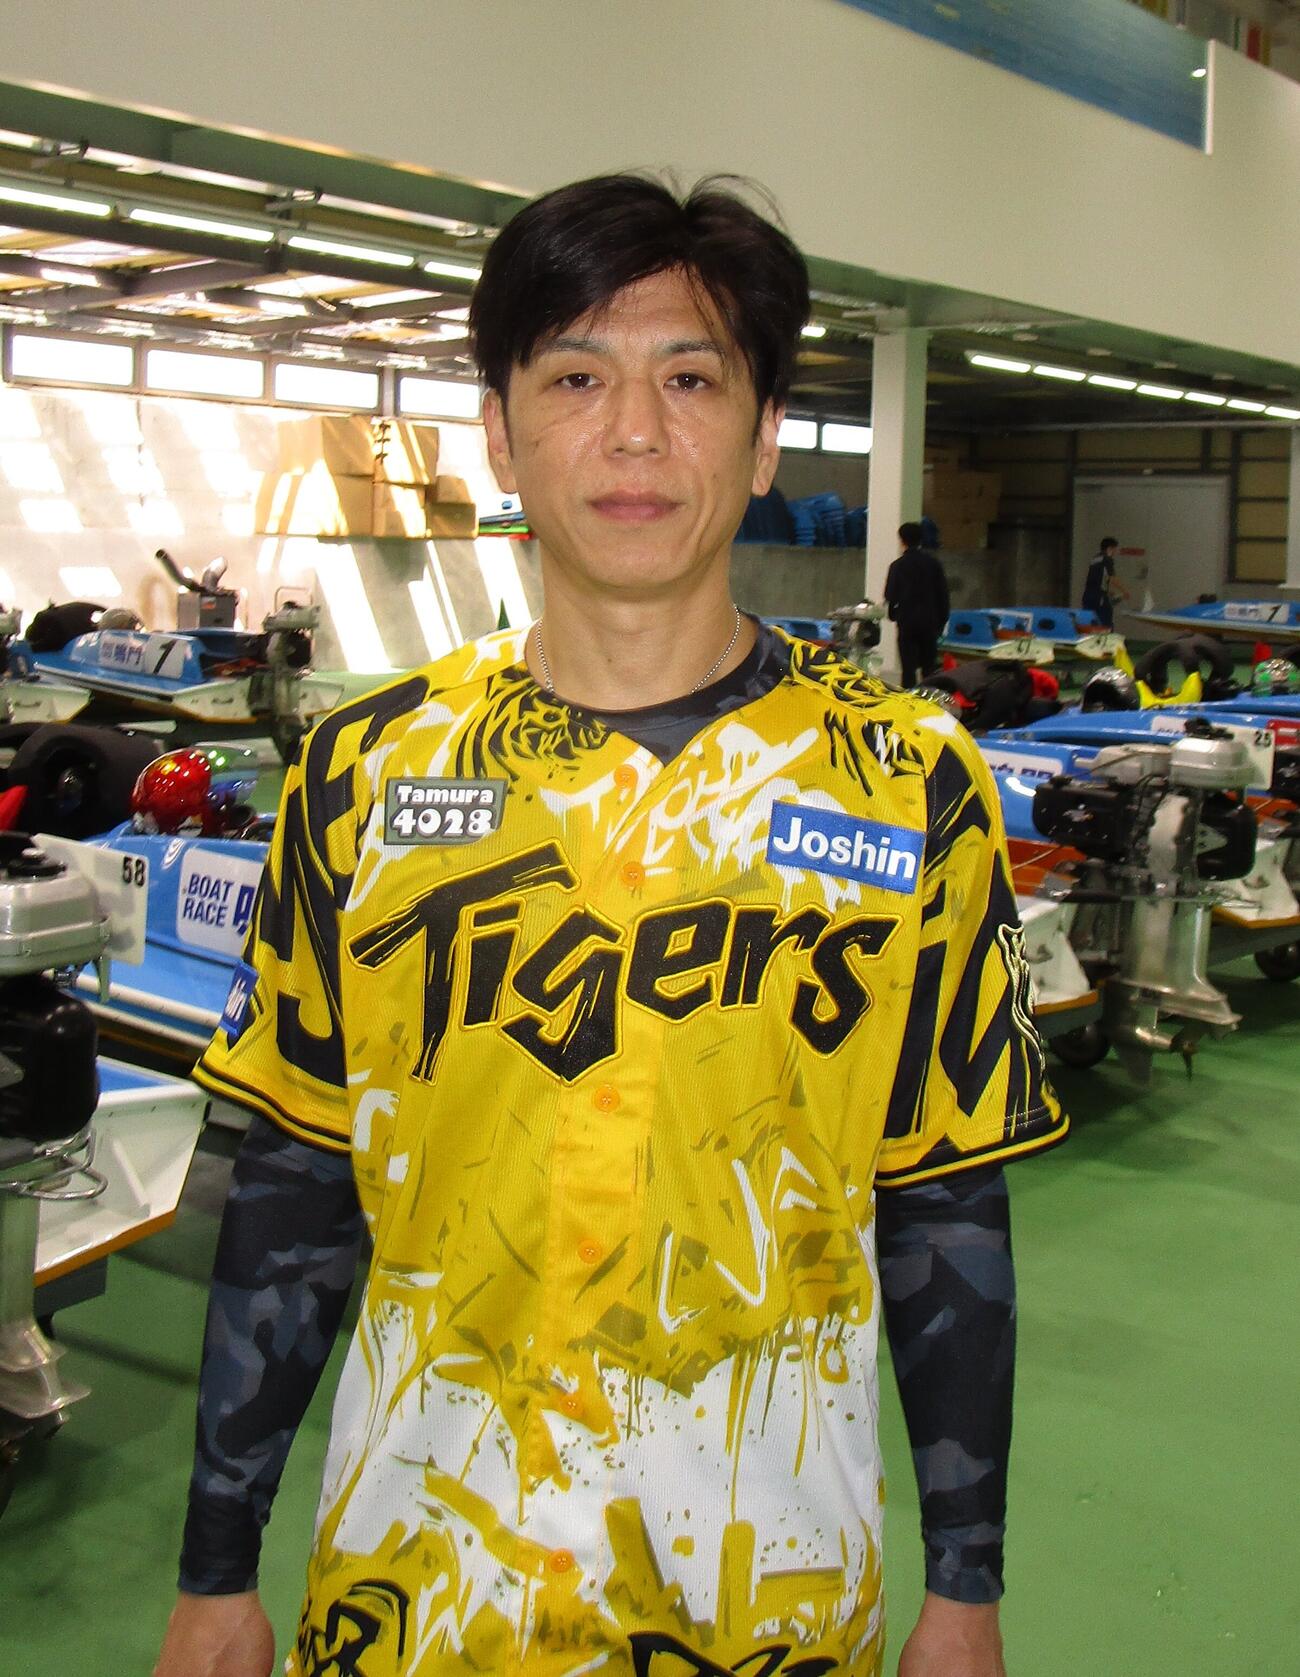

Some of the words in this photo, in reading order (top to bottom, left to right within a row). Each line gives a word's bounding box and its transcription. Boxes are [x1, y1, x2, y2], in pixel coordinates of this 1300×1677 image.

[397, 785, 494, 804] Tamura
[392, 808, 493, 836] 4028
[773, 816, 916, 879] Joshin
[122, 856, 145, 887] 58
[187, 873, 234, 902] BOAT
[183, 898, 228, 928] RACE
[347, 836, 905, 1087] Tigers
